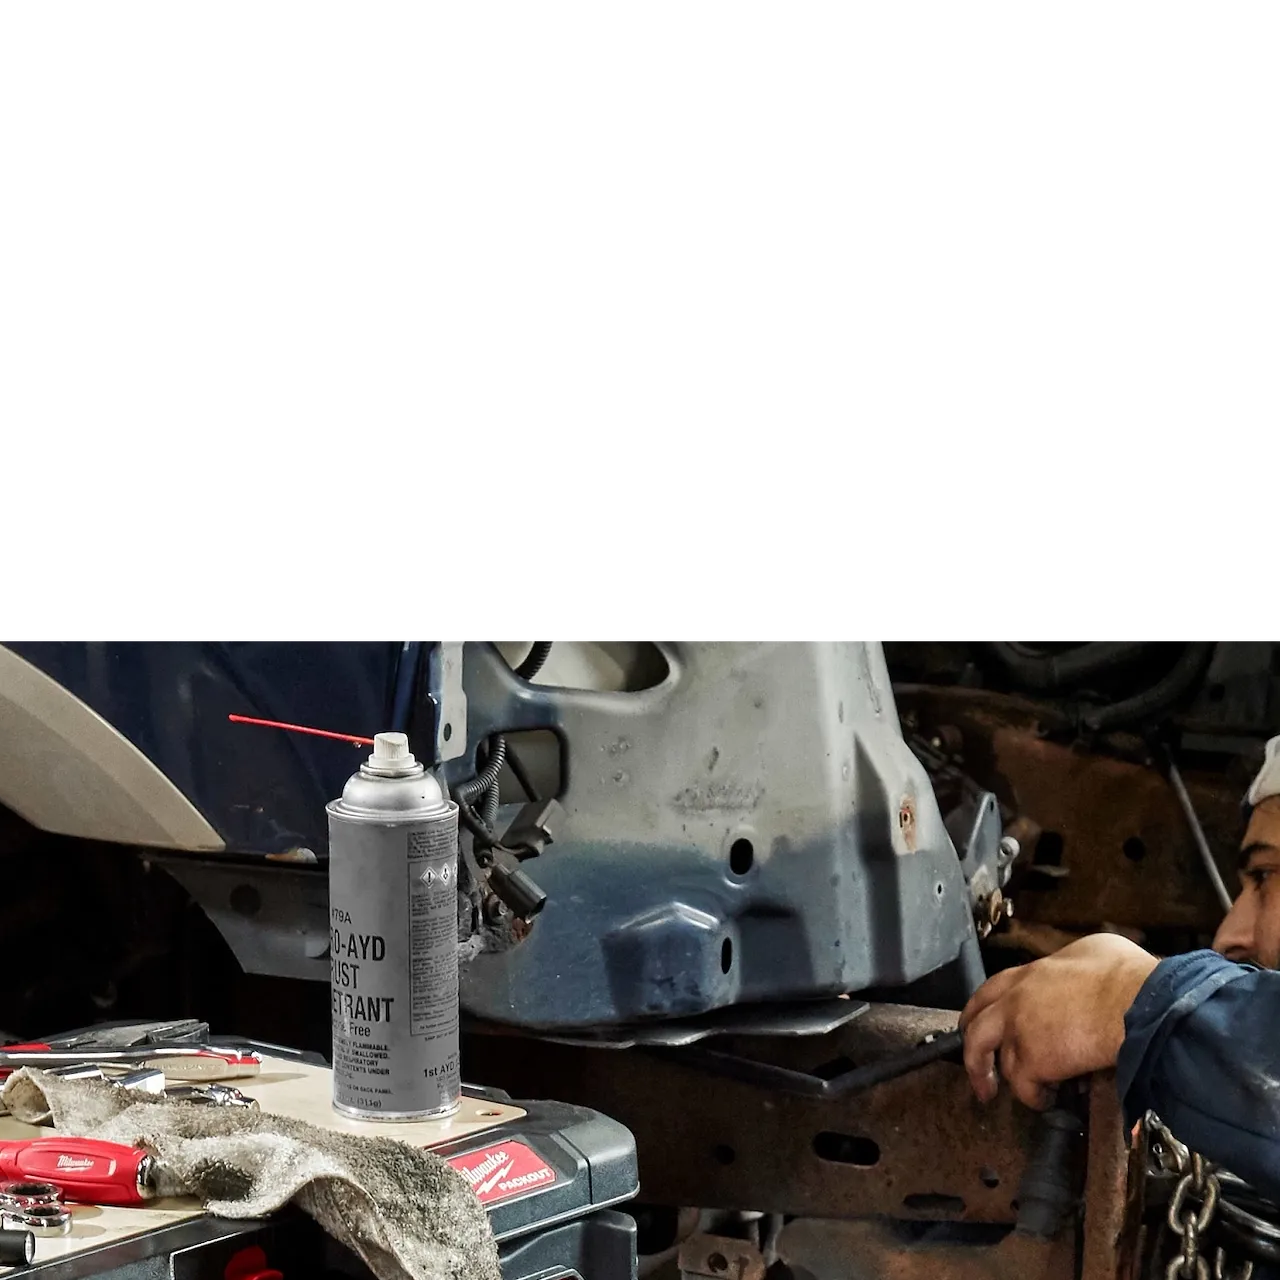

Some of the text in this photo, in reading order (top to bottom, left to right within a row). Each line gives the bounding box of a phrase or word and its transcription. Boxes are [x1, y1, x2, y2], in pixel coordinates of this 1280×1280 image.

[332, 908, 352, 925] 79A
[331, 957, 360, 989] UST
[349, 1022, 371, 1037] Free
[423, 1067, 438, 1078] 1st
[440, 1061, 455, 1074] AYD
[56, 1155, 95, 1168] Milwaukee
[458, 1151, 510, 1186] ilwaukee
[498, 1168, 551, 1191] PACKOUT
